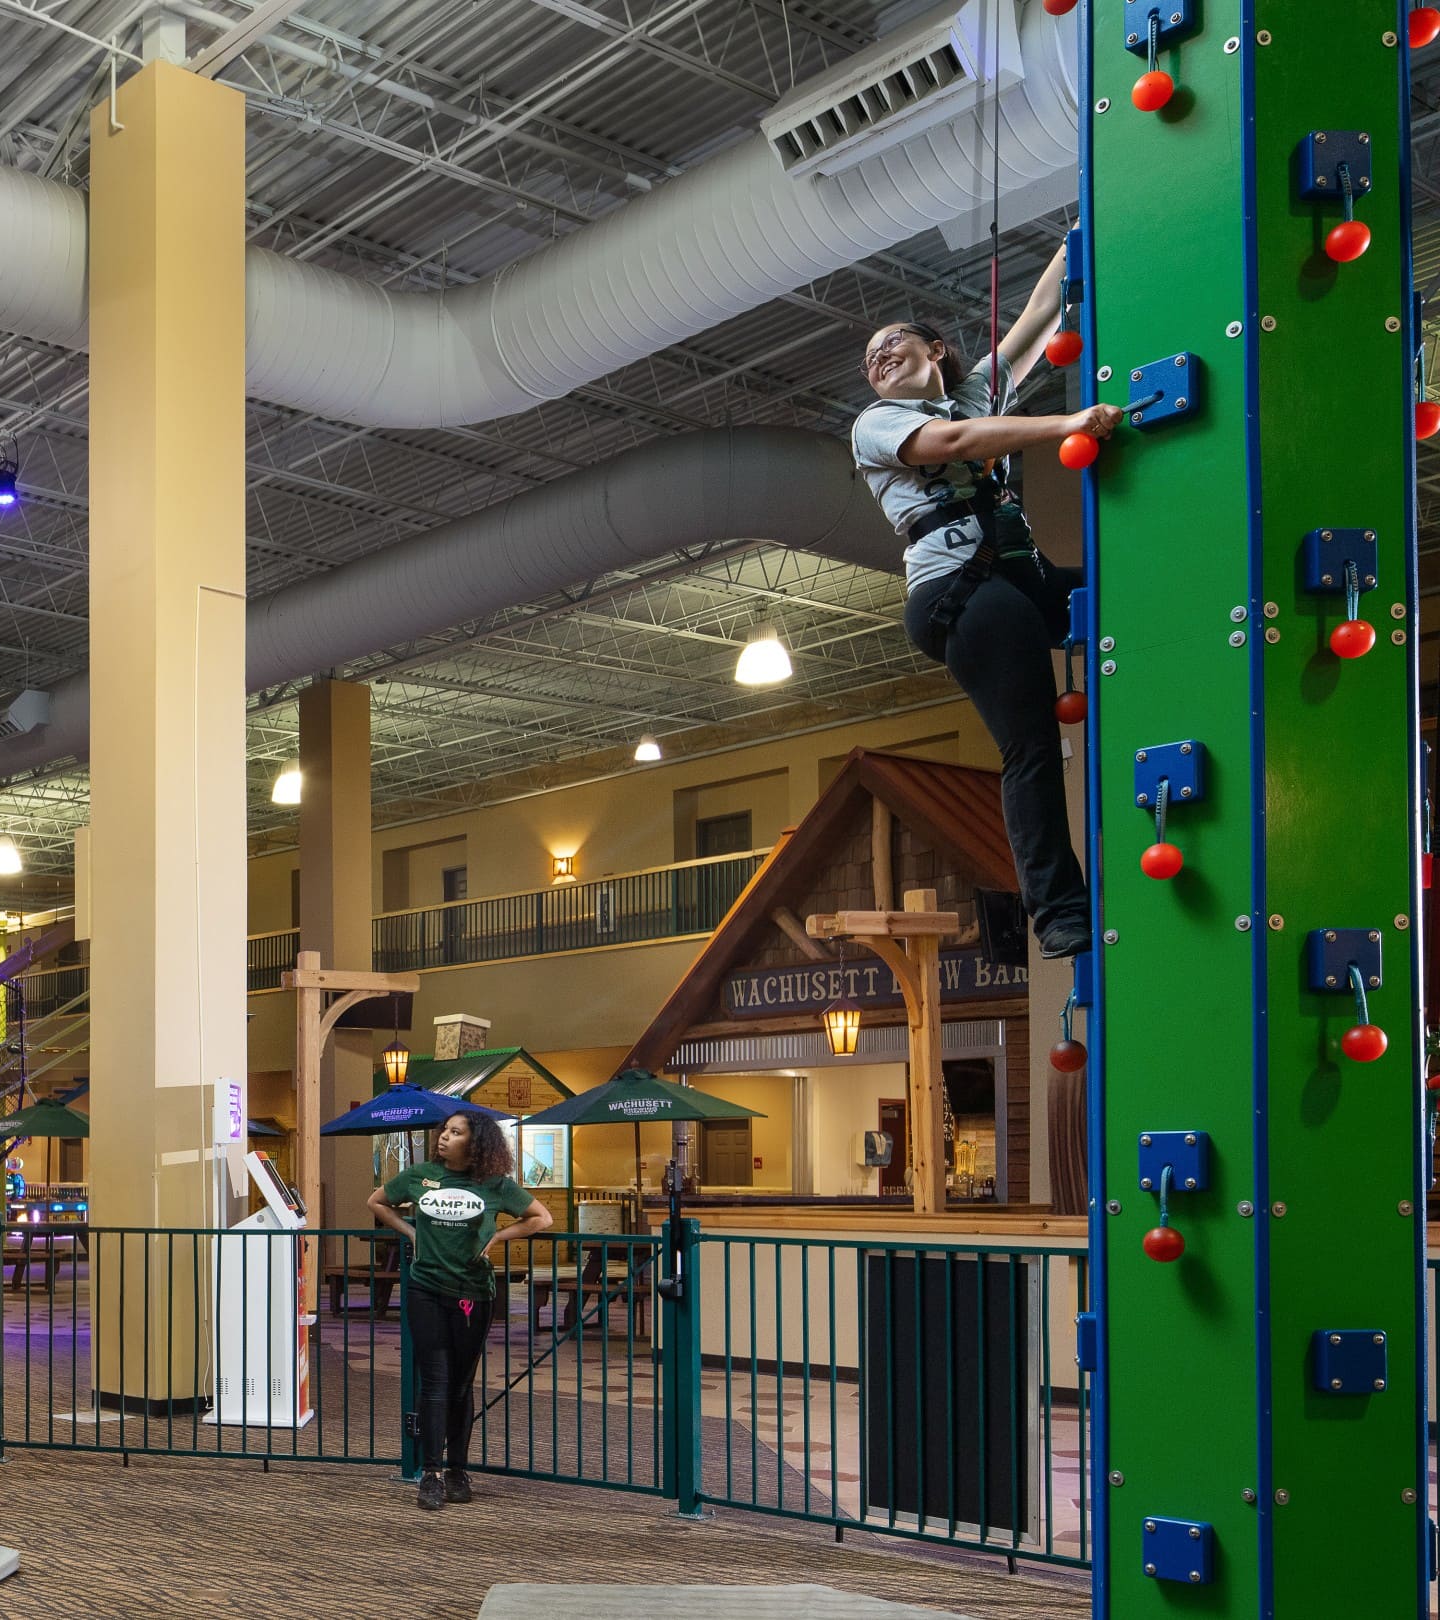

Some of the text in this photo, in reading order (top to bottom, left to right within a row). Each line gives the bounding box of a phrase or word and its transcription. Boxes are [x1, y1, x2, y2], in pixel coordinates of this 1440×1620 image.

[731, 967, 879, 1008] WACHUSETT
[608, 1099, 673, 1111] WACHUSETT
[371, 1108, 425, 1119] WACHUSETT
